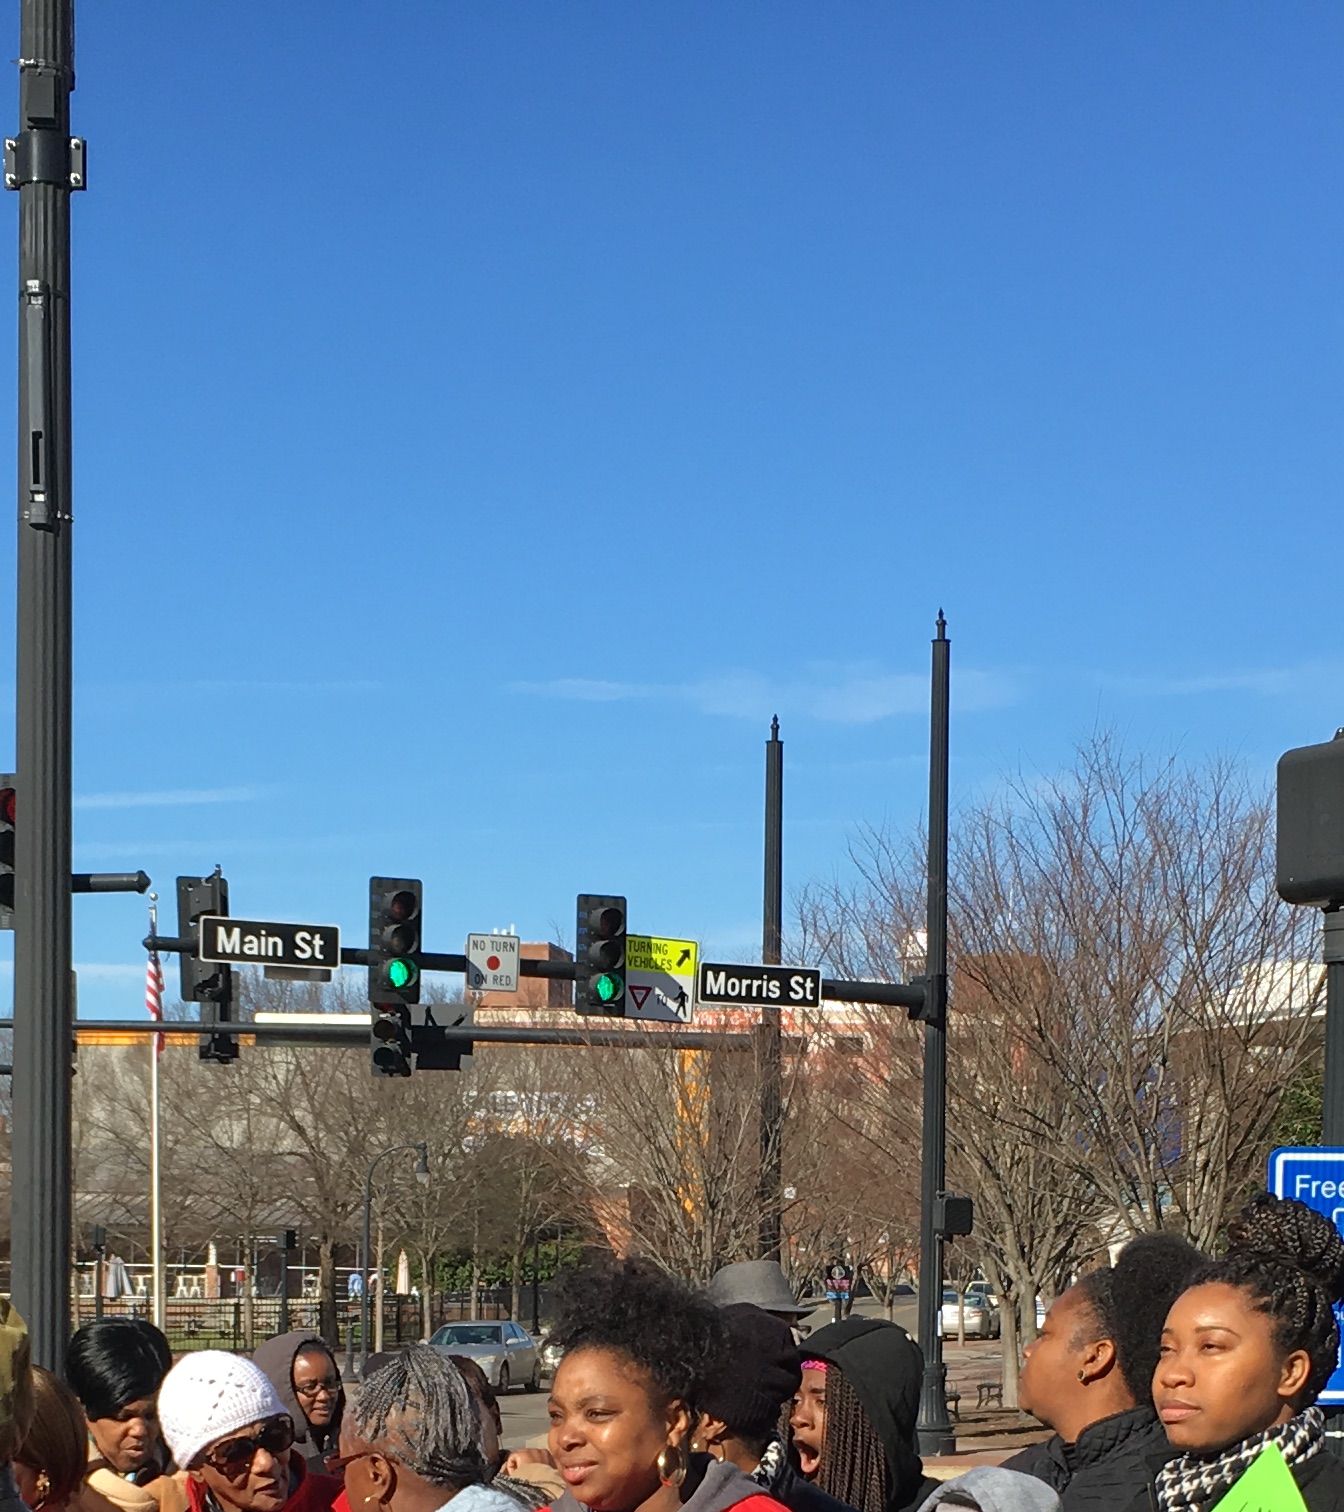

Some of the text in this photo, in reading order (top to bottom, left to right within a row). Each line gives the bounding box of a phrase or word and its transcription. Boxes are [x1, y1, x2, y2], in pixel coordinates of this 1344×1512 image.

[216, 926, 325, 960] Main St
[472, 940, 516, 953] NO TURN
[627, 940, 669, 955] TURNING
[627, 955, 673, 971] VEHICLES
[474, 973, 512, 987] ON RED
[706, 970, 814, 1000] Morris St
[655, 994, 668, 1006] TO
